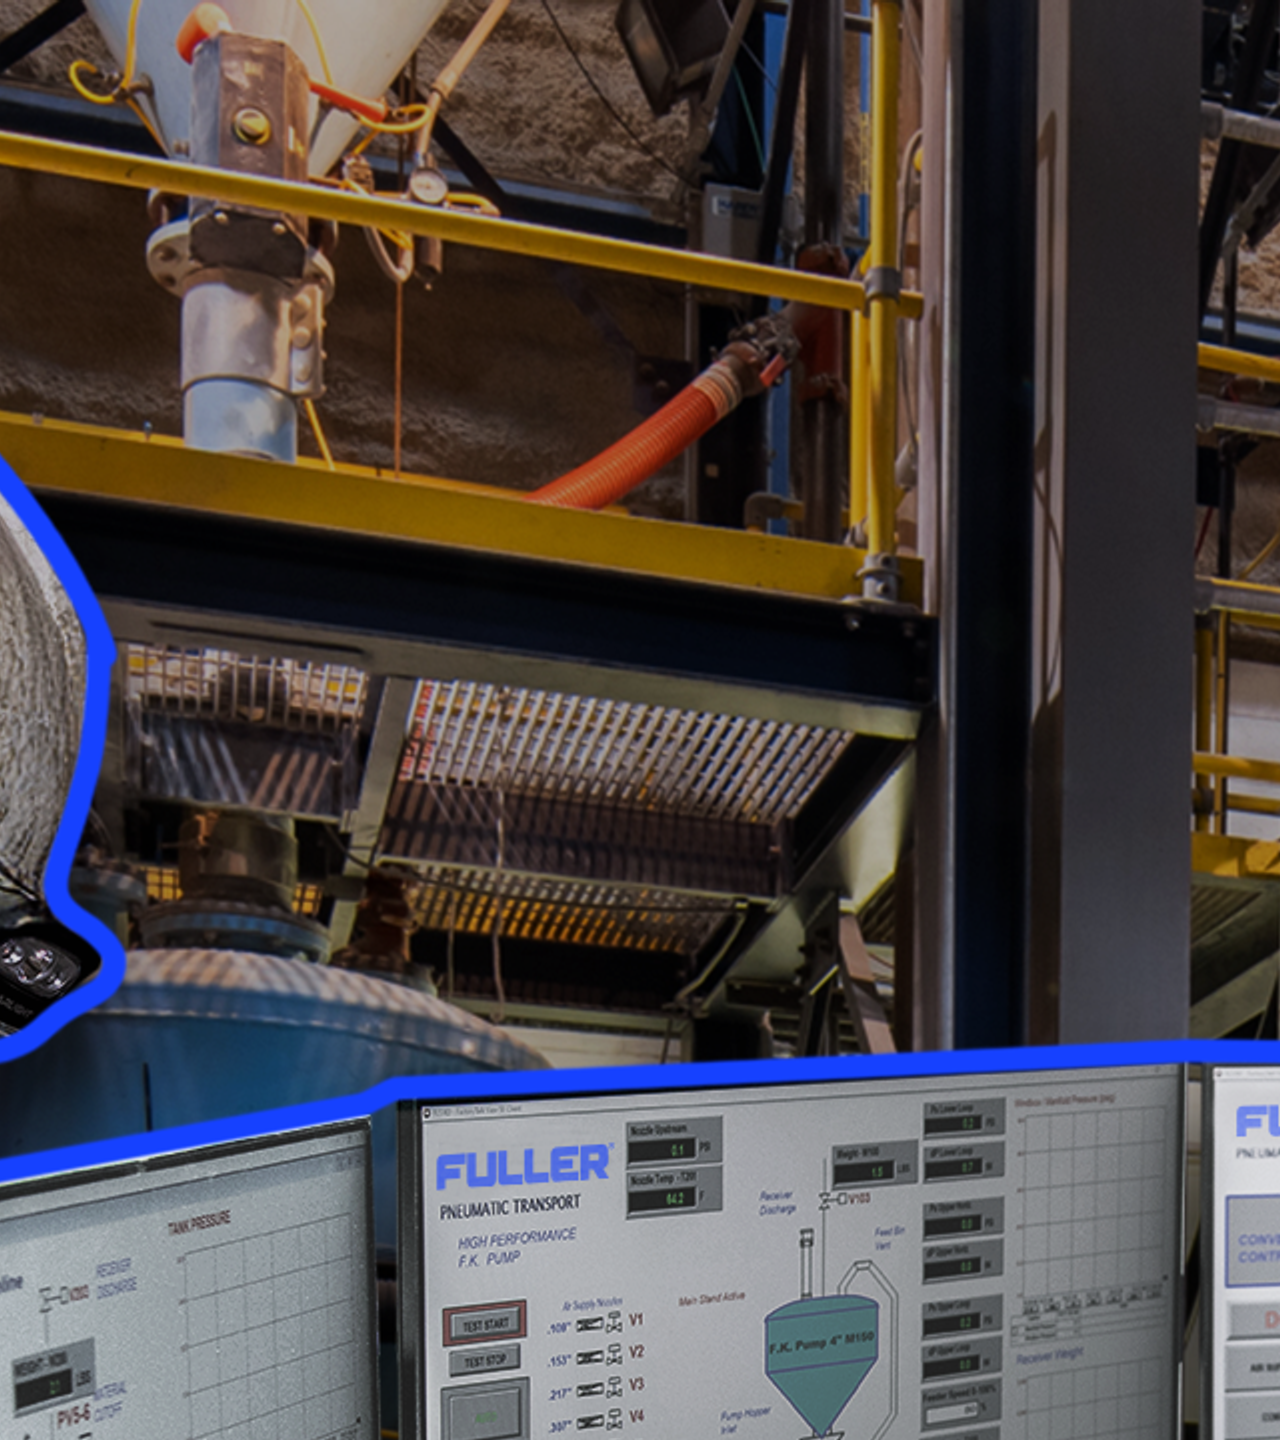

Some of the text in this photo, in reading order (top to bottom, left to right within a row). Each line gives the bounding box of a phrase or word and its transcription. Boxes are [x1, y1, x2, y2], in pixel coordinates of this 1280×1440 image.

[630, 1124, 654, 1136] Nozzle
[436, 1144, 610, 1191] FULLER
[630, 1173, 673, 1187] Nozzle Temp
[759, 1190, 793, 1201] Receiver
[439, 1194, 581, 1220] PNEUMATIC TRANSPORT
[759, 1204, 797, 1217] Discharge
[169, 1209, 232, 1236] TANK PRESSURE
[458, 1227, 578, 1250] HIGH PERFORMANCE
[875, 1227, 894, 1238] Feed
[875, 1241, 891, 1251] Vent
[458, 1250, 522, 1268] F.K. PUMP
[572, 1299, 593, 1312] Supply
[679, 1291, 746, 1307] Main Stand Active
[463, 1317, 509, 1333] TEST START
[629, 1313, 645, 1327] V1
[770, 1342, 793, 1355] F.K.
[795, 1338, 827, 1352] Pump
[830, 1334, 842, 1346] 4"
[629, 1345, 645, 1359] V2
[1017, 1350, 1052, 1365] Receiver
[464, 1353, 507, 1368] TEST STOP
[1250, 1362, 1264, 1373] AIR
[629, 1377, 645, 1391] V3
[948, 1389, 970, 1400] Speed
[475, 1411, 497, 1424] AUTO
[629, 1409, 645, 1423] V4
[721, 1407, 771, 1422] Pump Hopper
[721, 1424, 737, 1435] Inlet
